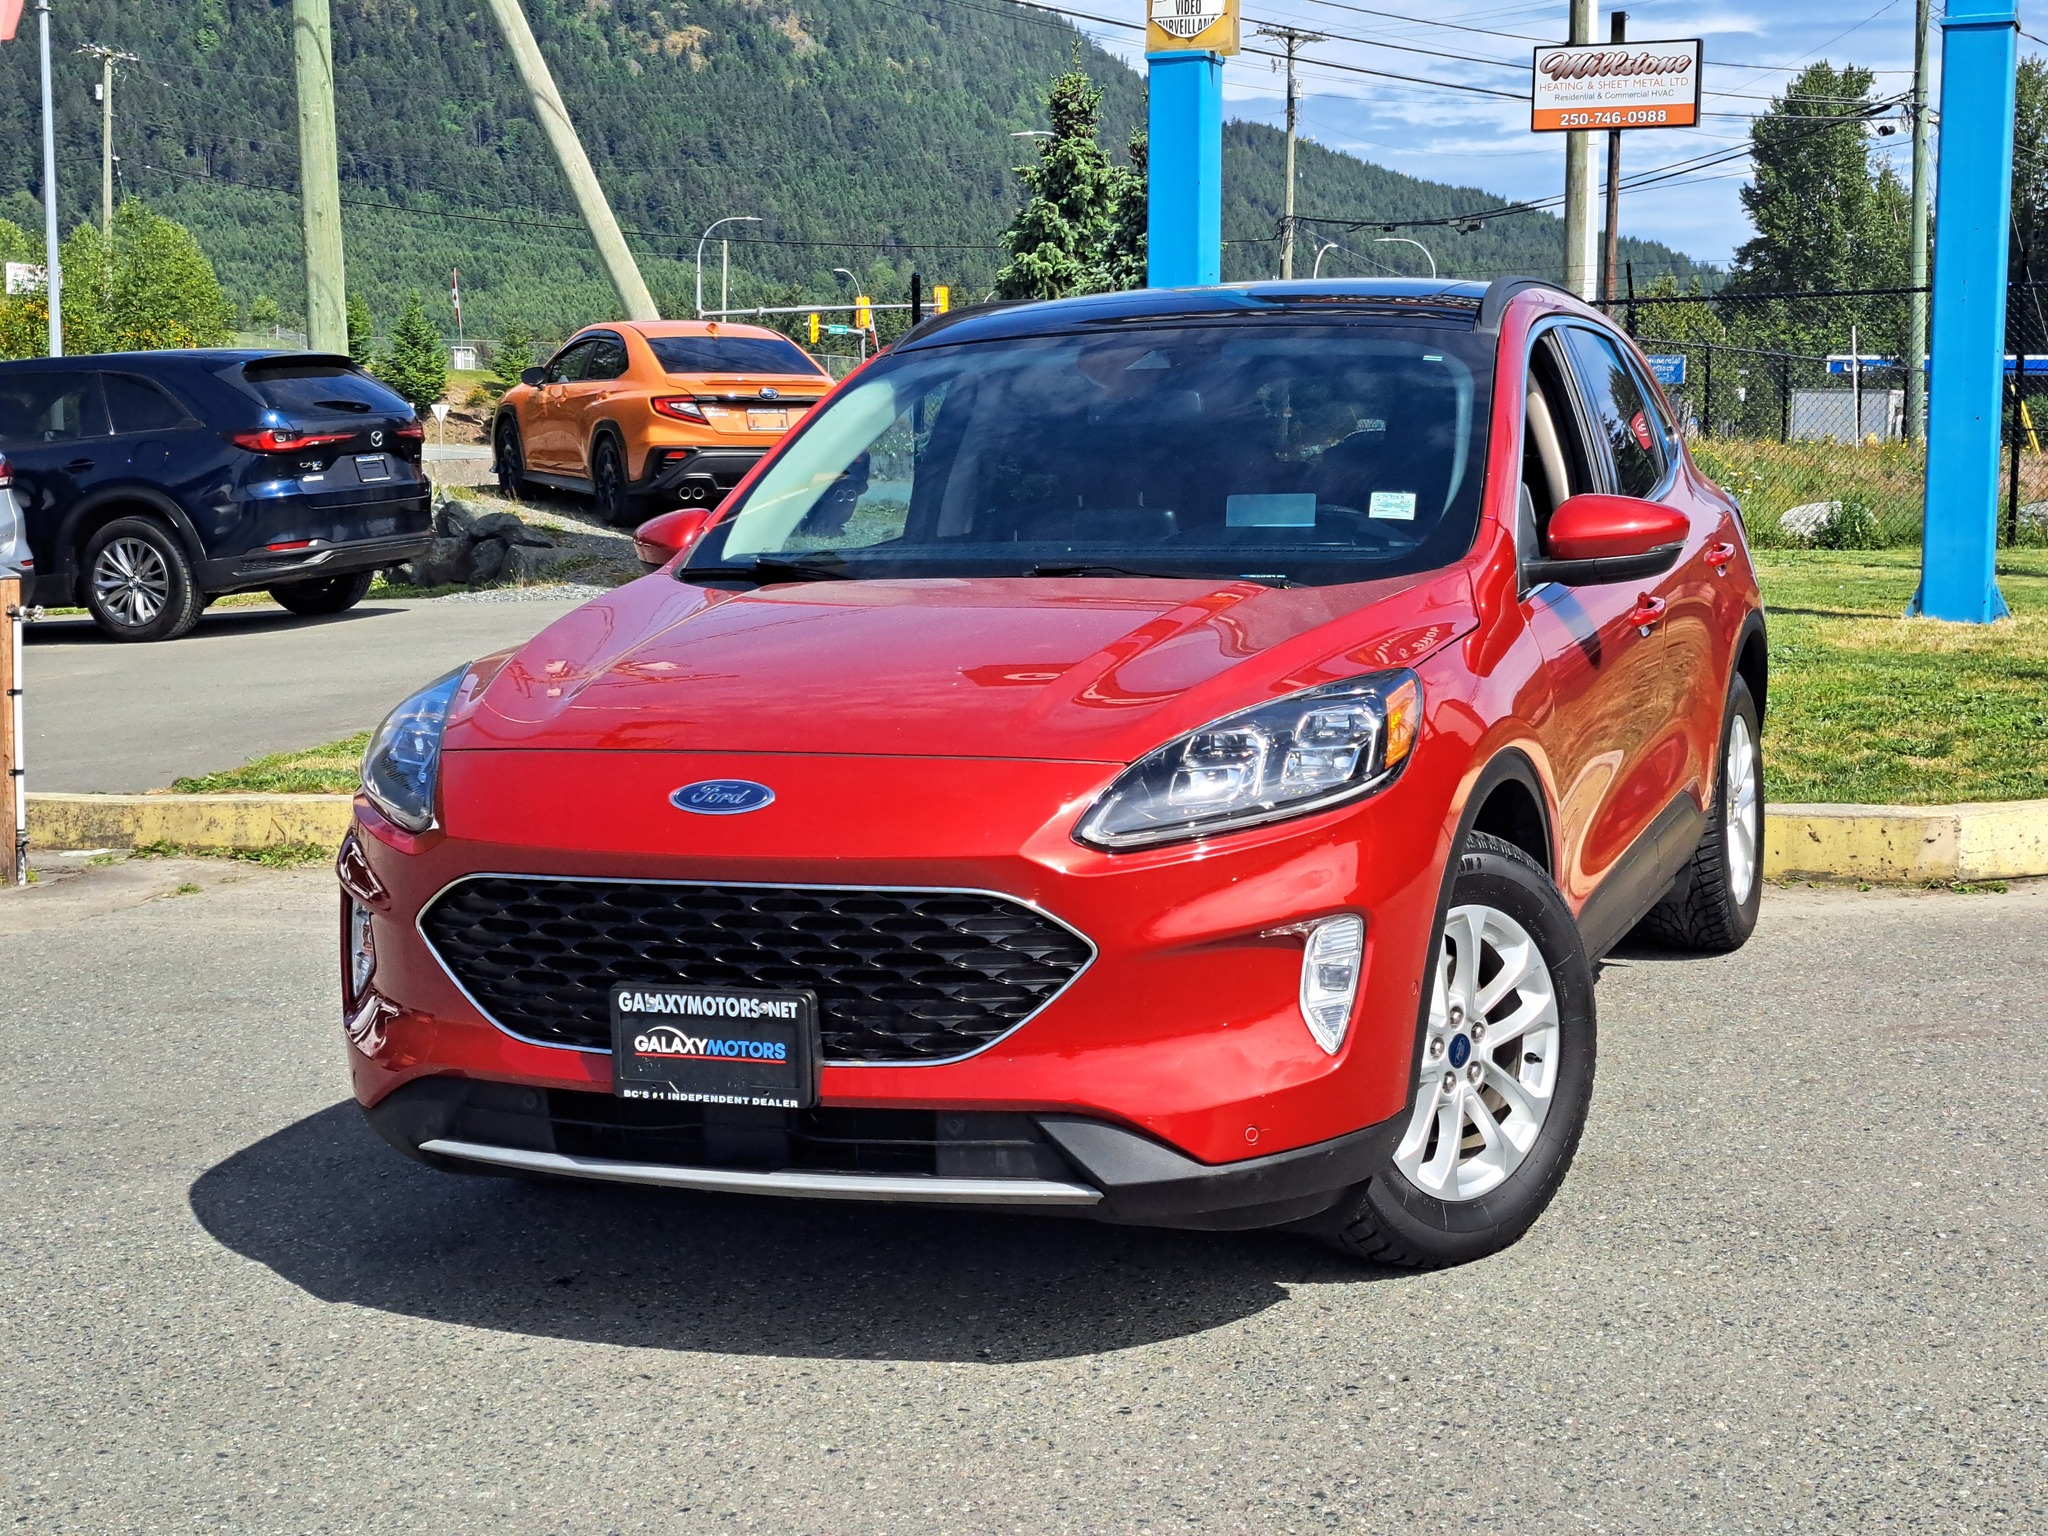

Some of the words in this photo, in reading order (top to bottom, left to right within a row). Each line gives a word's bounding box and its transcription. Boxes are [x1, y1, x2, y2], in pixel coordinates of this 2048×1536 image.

[1175, 0, 1202, 15] VIDEO
[1539, 50, 1692, 81] Millstone
[1539, 81, 1583, 92] HEATING
[1587, 82, 1594, 90] &
[1598, 80, 1630, 90] SHEET
[1633, 78, 1665, 88] METAL
[1554, 92, 1595, 101] Residential
[1597, 91, 1603, 100] &
[1604, 90, 1650, 100] Commercial
[1651, 89, 1674, 98] HVAC
[1560, 110, 1667, 126] 250-746-0988
[691, 784, 751, 804] Ford
[618, 991, 798, 1019] GALAXYMOTORSNET
[623, 1089, 650, 1099] BC'S
[652, 1091, 664, 1100] #1
[667, 1092, 749, 1105] INDEPENDENT
[752, 1097, 798, 1108] DEALER
